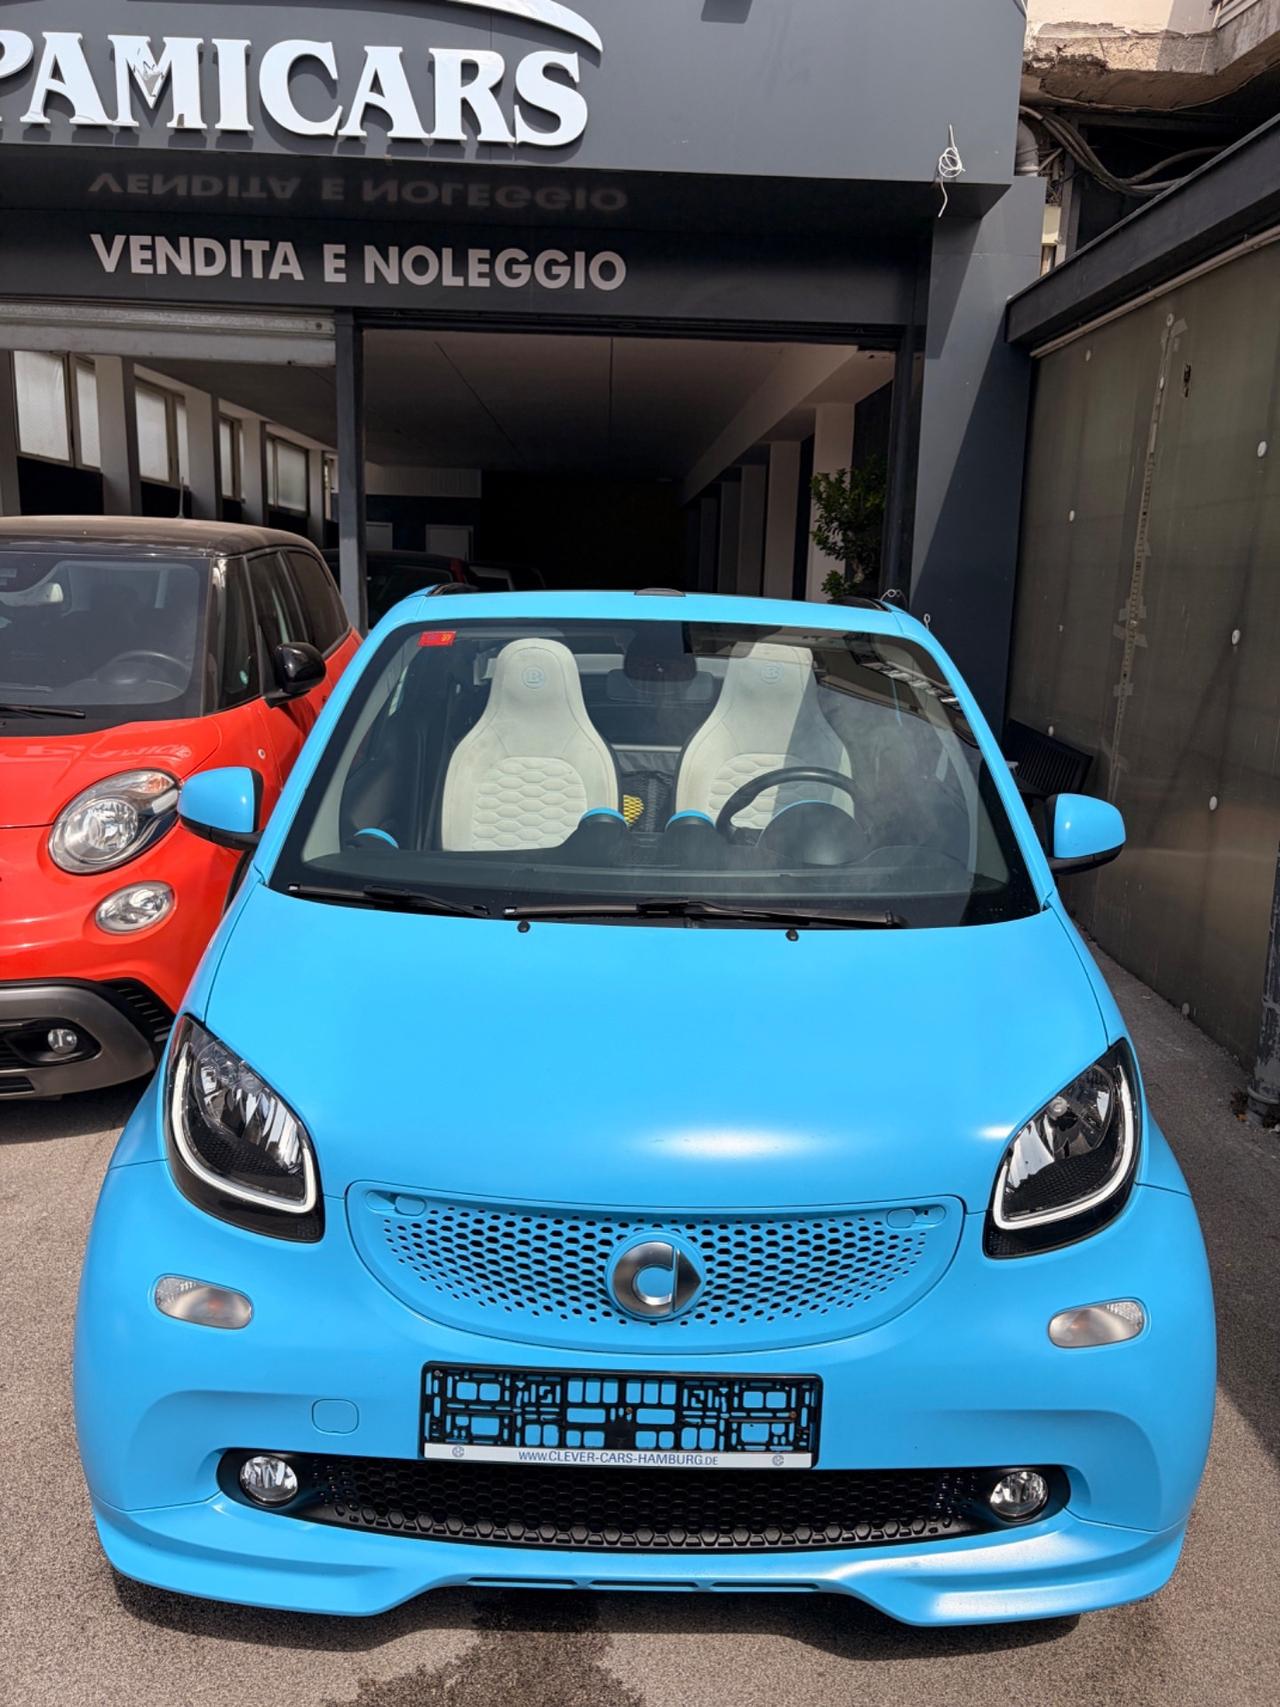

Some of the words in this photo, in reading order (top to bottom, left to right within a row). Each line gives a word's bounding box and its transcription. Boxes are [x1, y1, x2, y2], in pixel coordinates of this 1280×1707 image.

[90, 233, 304, 281] VENDITA
[323, 243, 347, 283] E
[364, 245, 627, 291] NOLEGGIO
